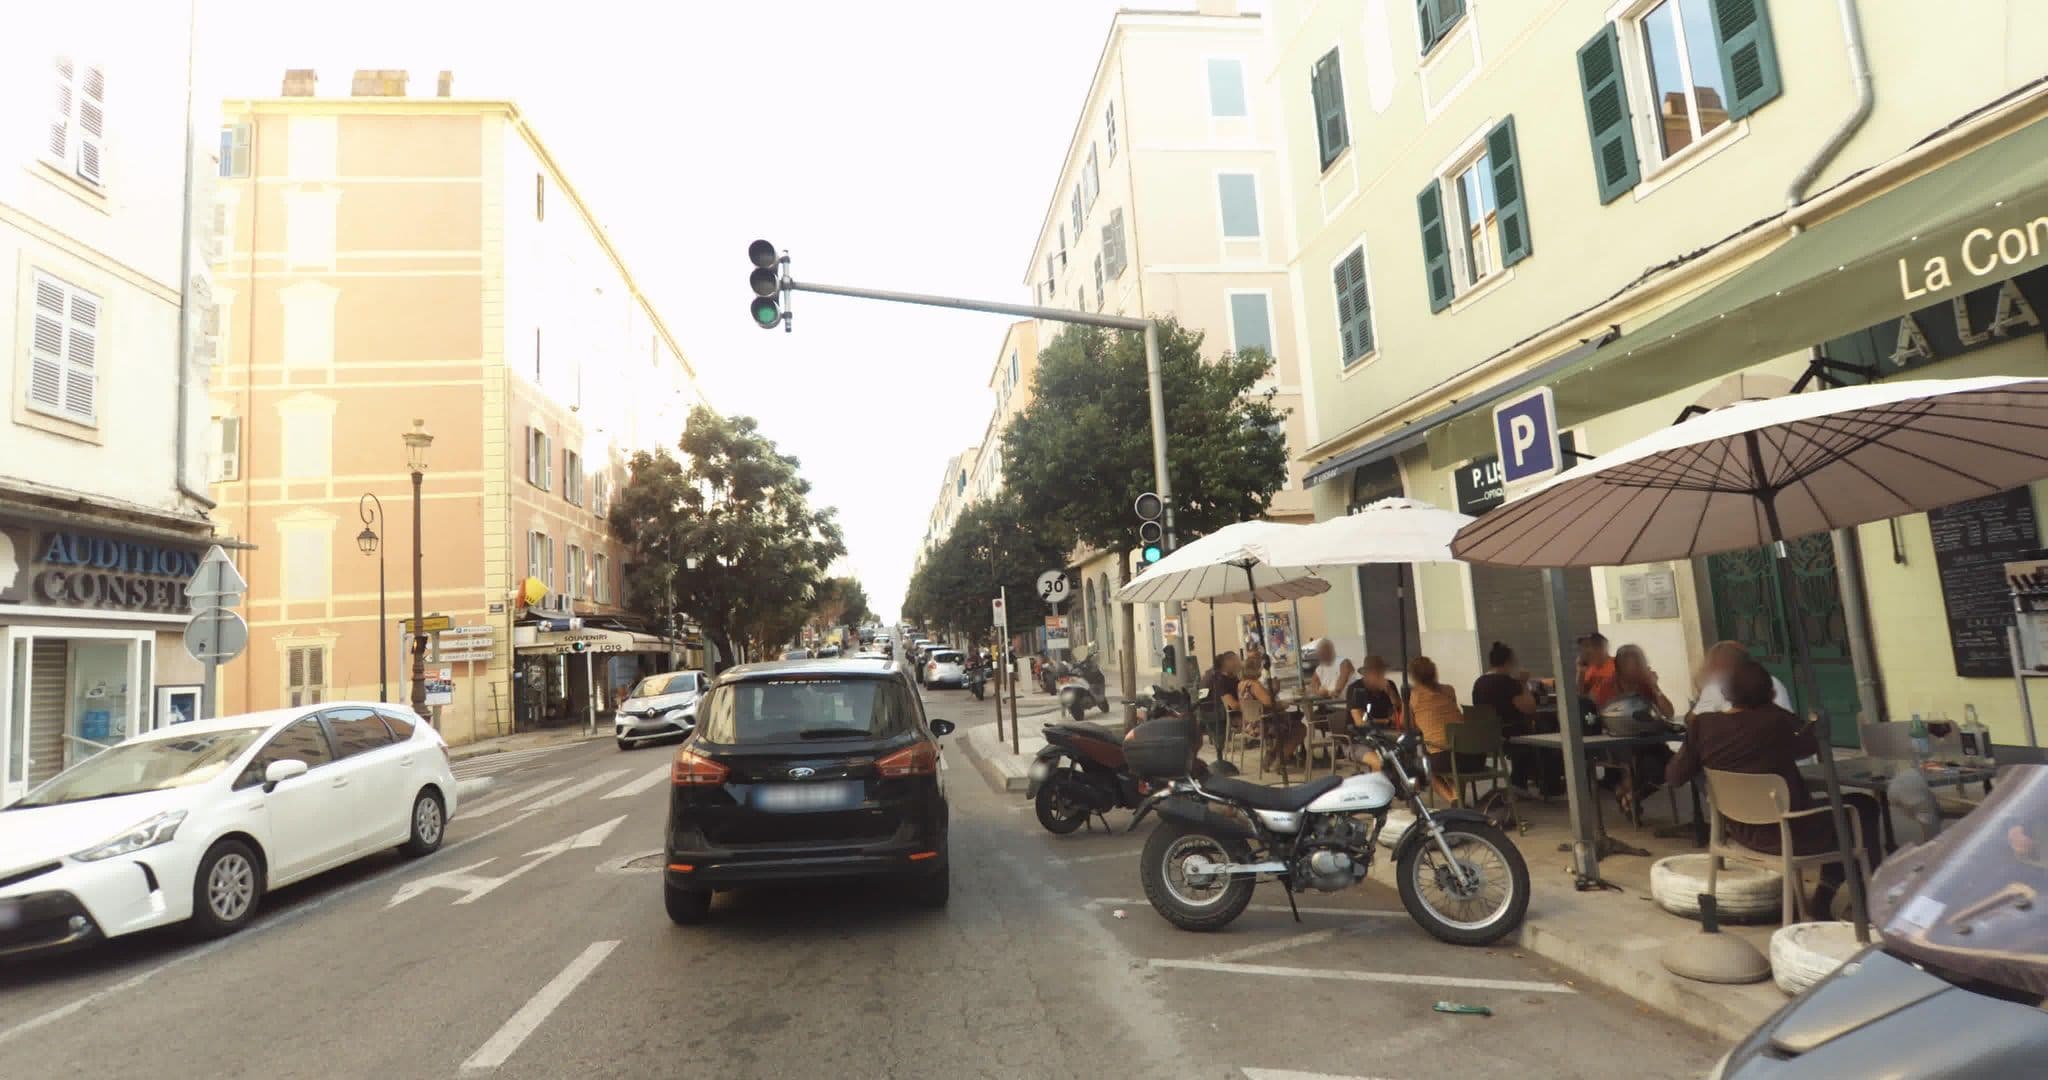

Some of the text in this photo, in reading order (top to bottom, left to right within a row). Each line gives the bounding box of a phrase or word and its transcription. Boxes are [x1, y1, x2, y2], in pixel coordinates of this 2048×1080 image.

[1898, 217, 2048, 301] La Con
[1888, 280, 2041, 368] A LA
[1510, 414, 1536, 467] P
[1471, 468, 1485, 489] P.
[42, 533, 199, 577] AUDITION
[43, 570, 191, 609] CONSEI
[1044, 580, 1064, 593] 30
[564, 633, 608, 642] SOUVENIRS
